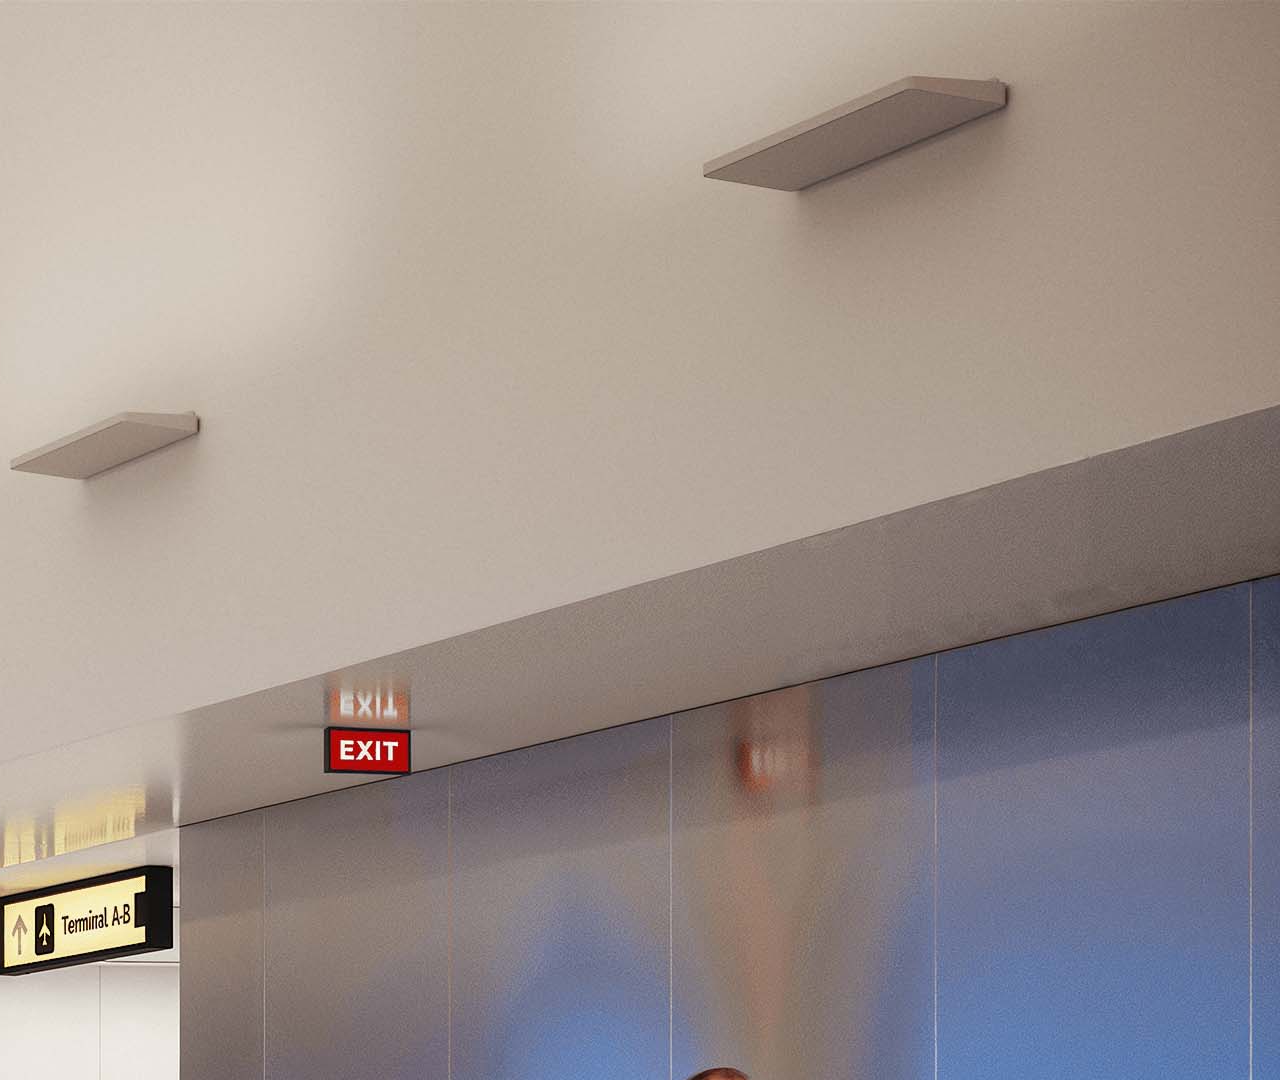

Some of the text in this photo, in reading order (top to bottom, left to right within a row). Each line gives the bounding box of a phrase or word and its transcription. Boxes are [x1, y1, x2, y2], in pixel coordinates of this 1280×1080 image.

[339, 740, 399, 761] EXIT
[61, 903, 131, 936] Terminal A-B
